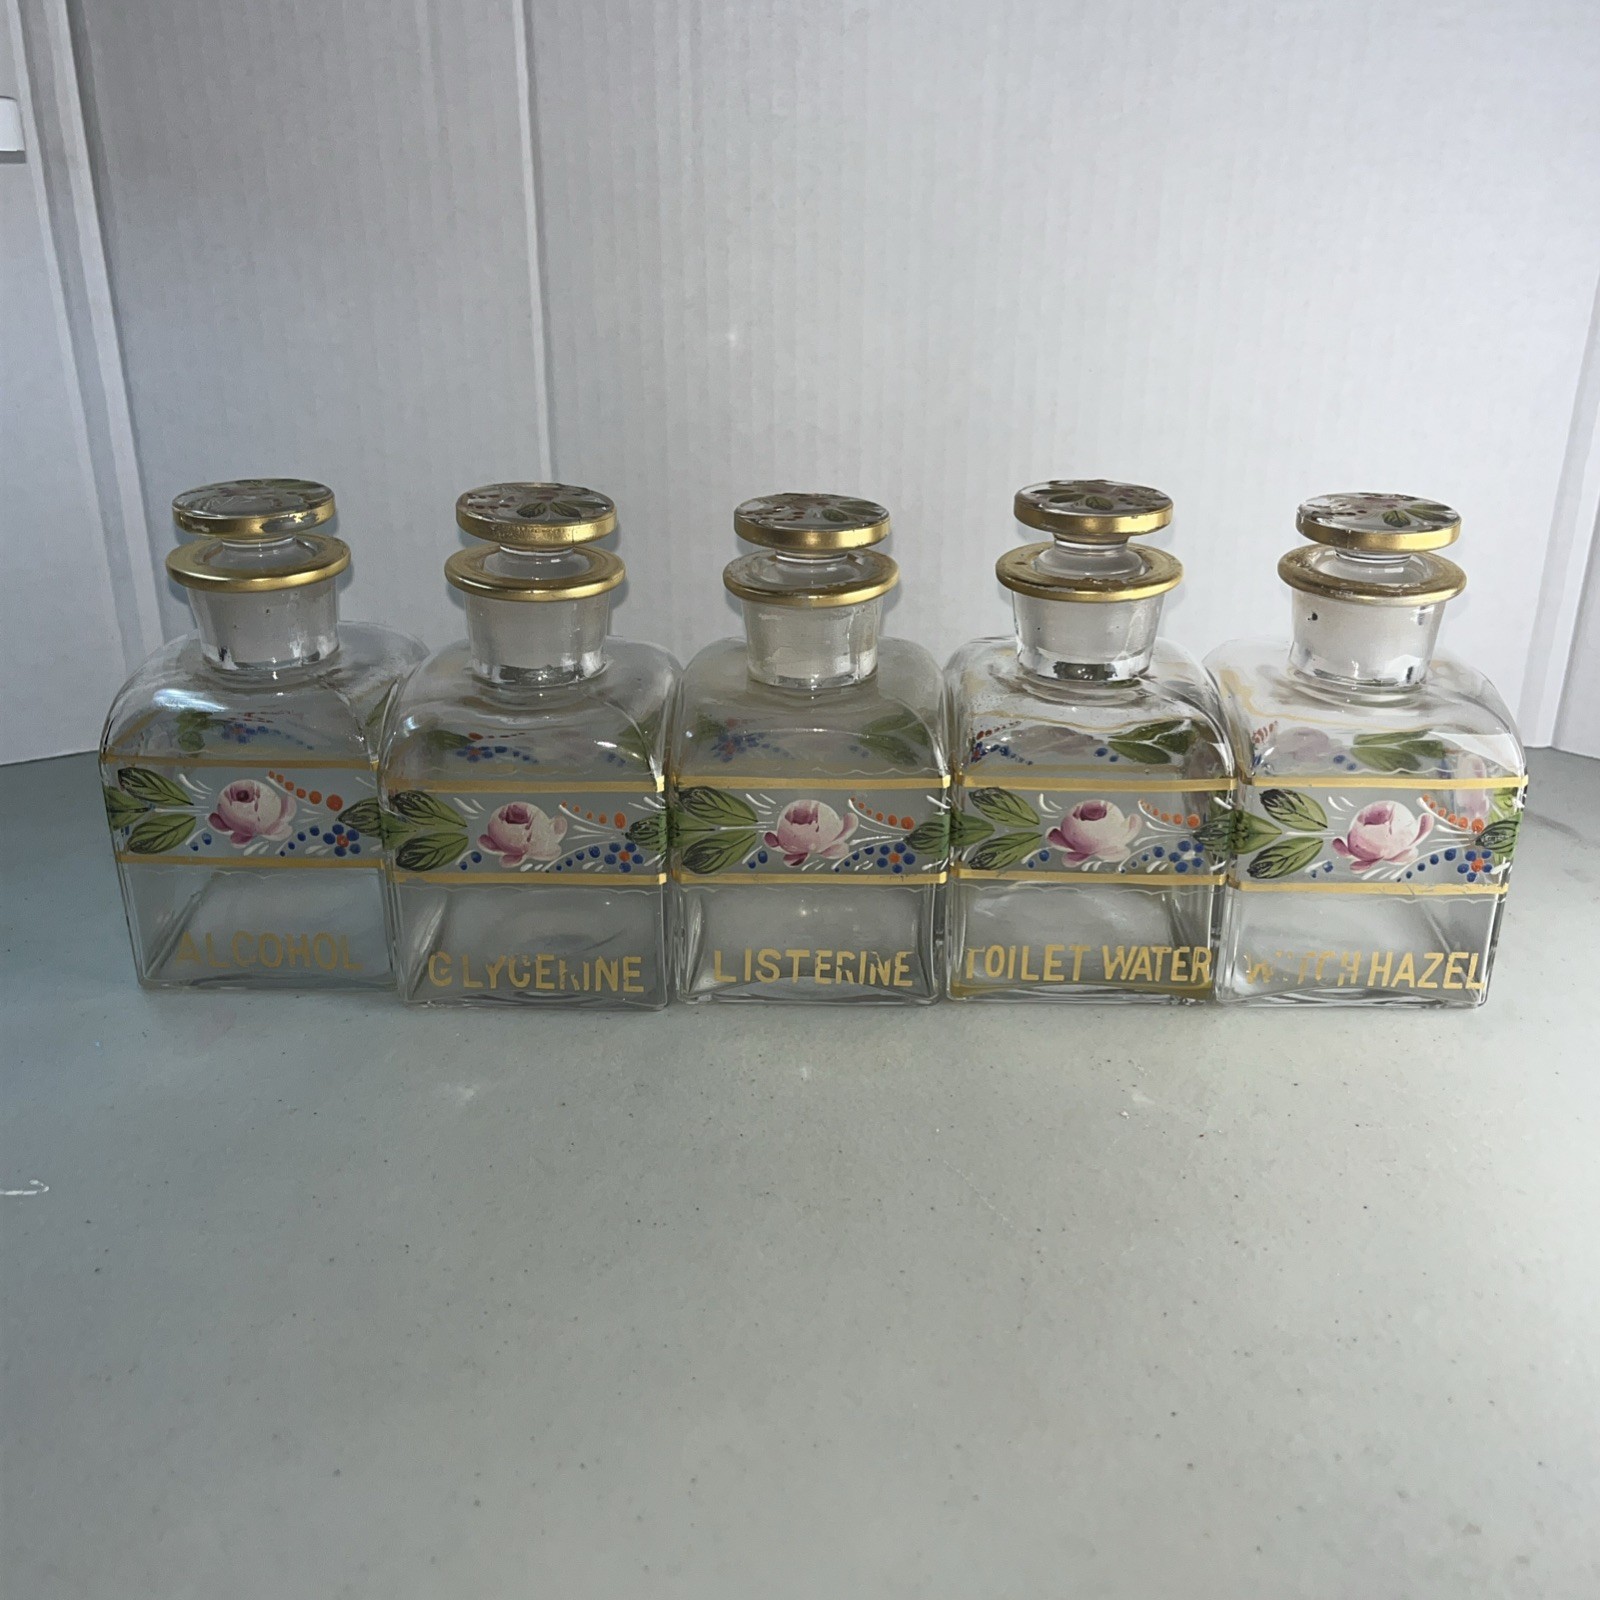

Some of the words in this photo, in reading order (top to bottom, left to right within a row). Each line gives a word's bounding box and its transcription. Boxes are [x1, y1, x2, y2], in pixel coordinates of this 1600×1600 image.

[175, 931, 363, 970] ALCOHOL
[713, 948, 914, 987] LISTERINE
[965, 945, 1091, 982] TOILET
[1102, 945, 1212, 983] WATER
[1243, 950, 1362, 987] WTCH
[1366, 951, 1485, 990] HAZEL
